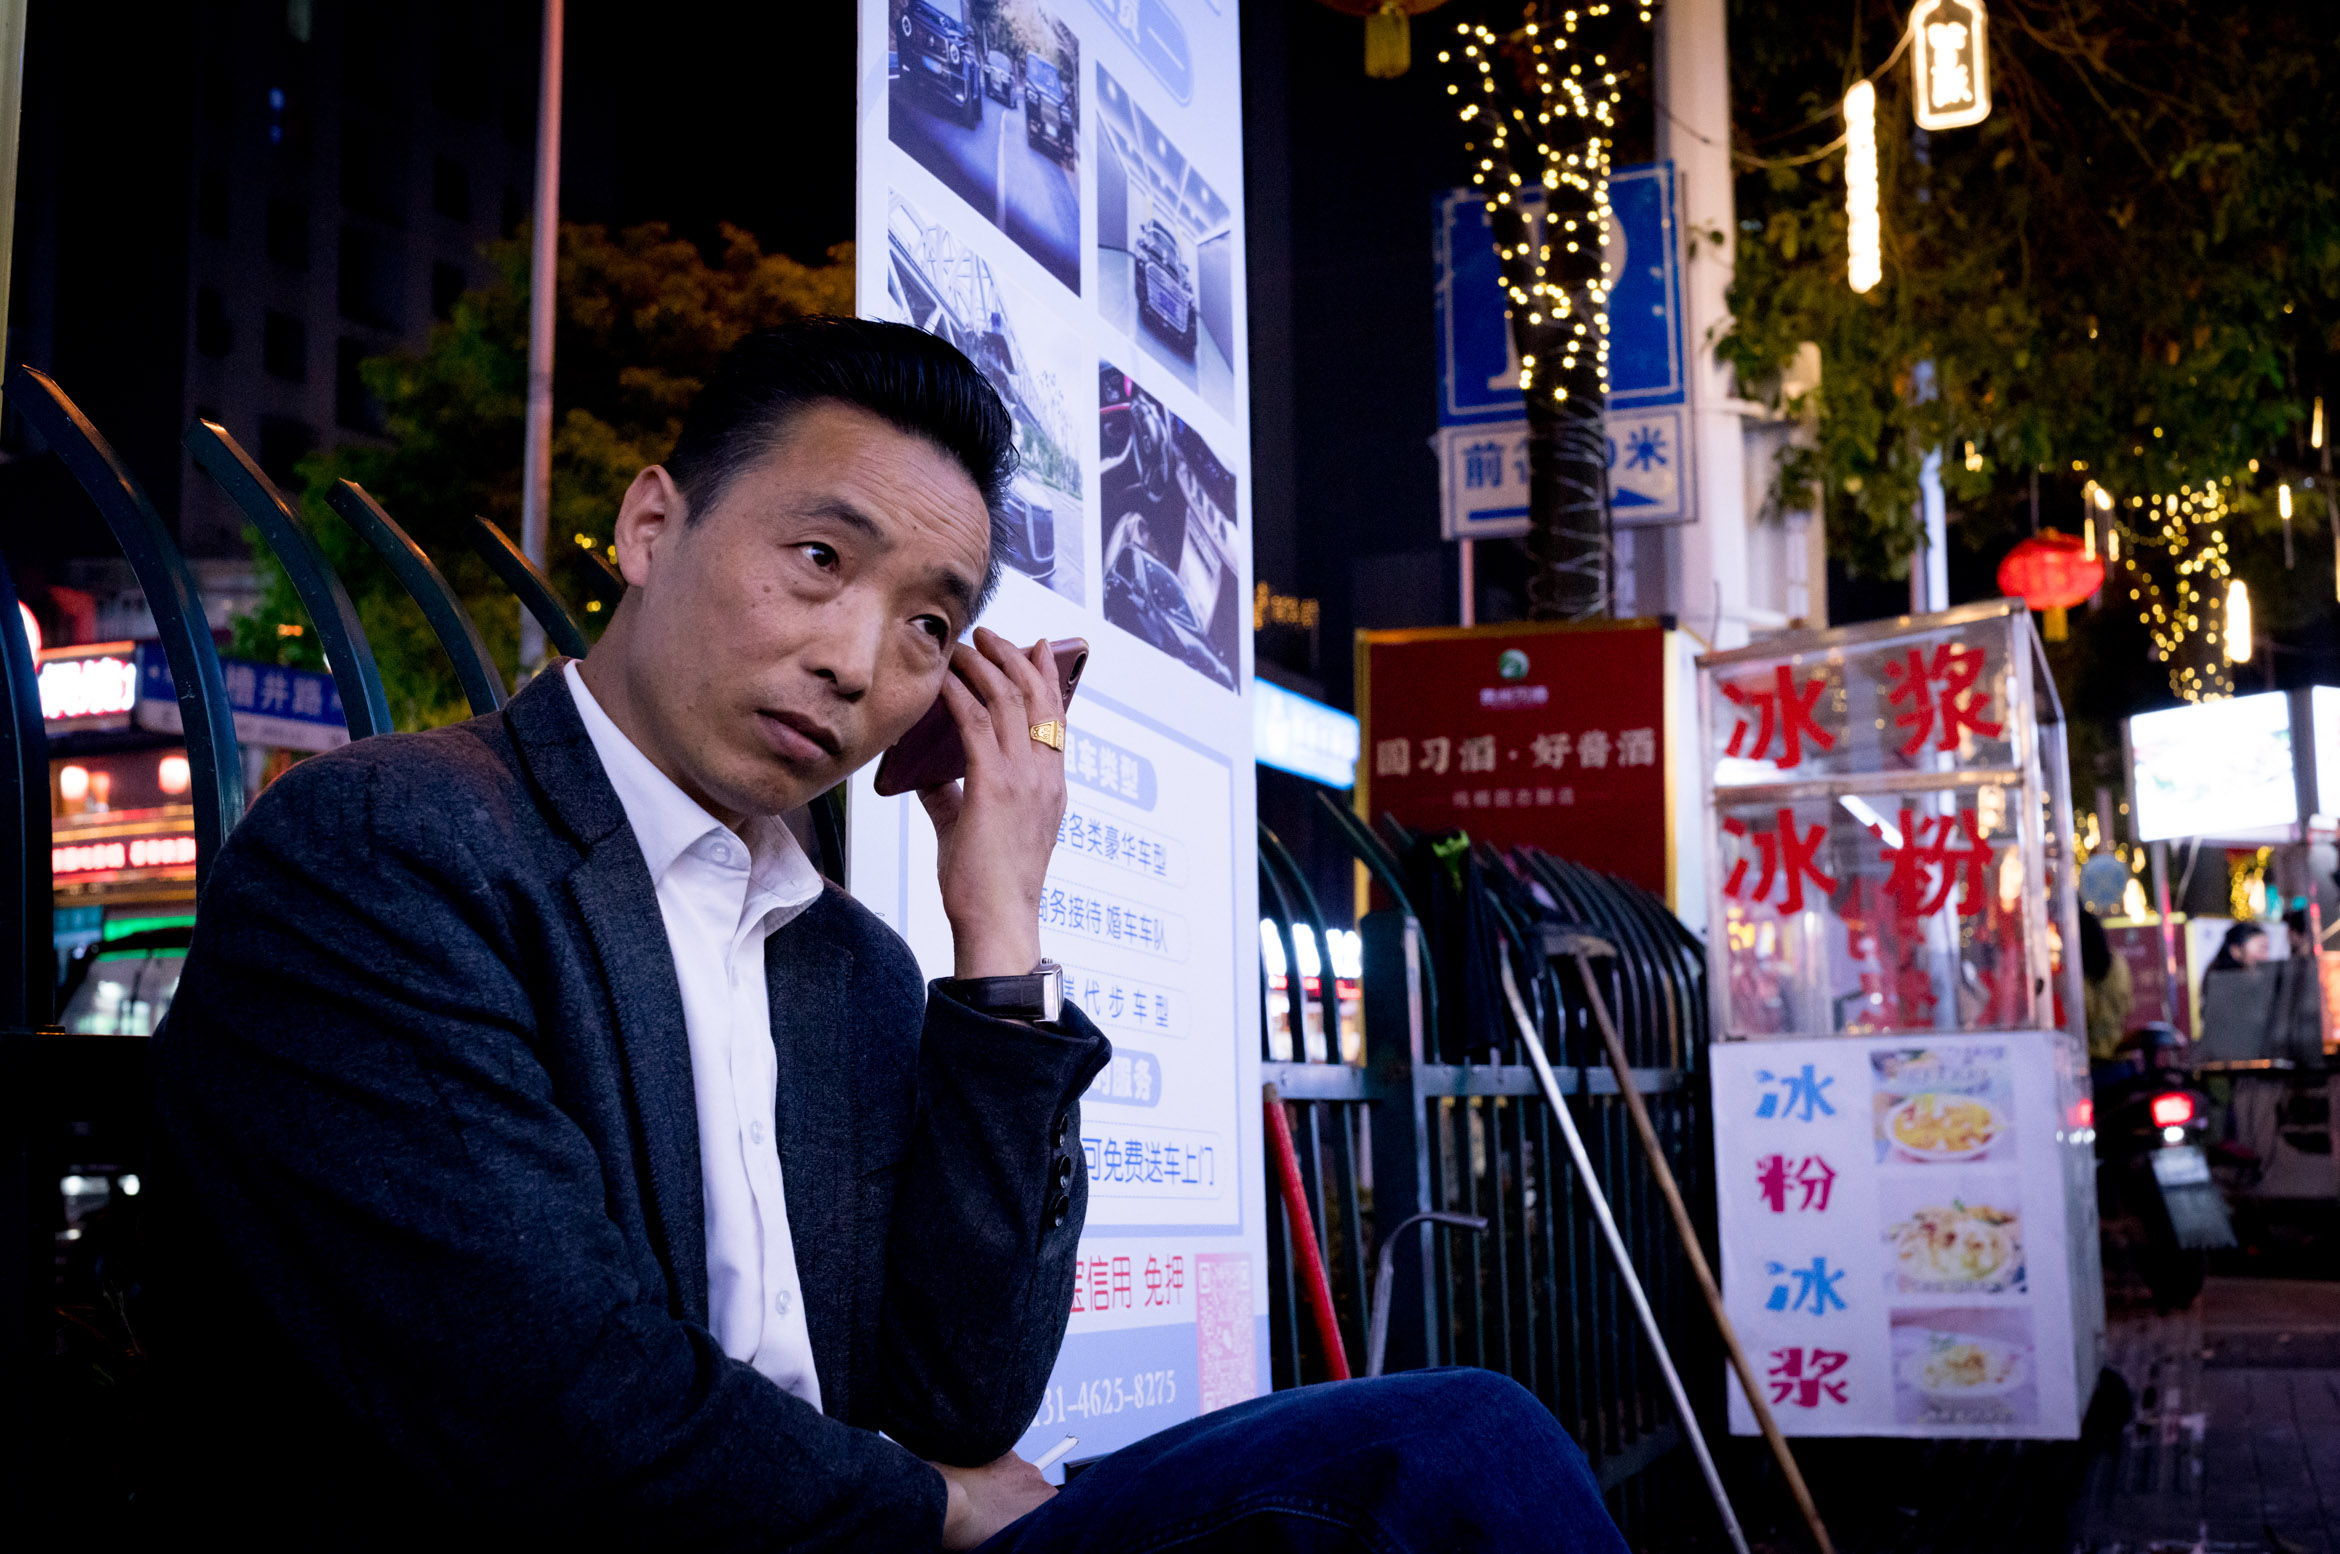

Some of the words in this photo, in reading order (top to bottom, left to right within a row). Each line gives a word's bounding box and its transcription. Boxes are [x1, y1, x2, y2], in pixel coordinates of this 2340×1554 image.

[1722, 644, 2003, 770] 冰浆
[1722, 807, 1995, 918] 冰粉
[1081, 1137, 1215, 1186] 可免费送车上门
